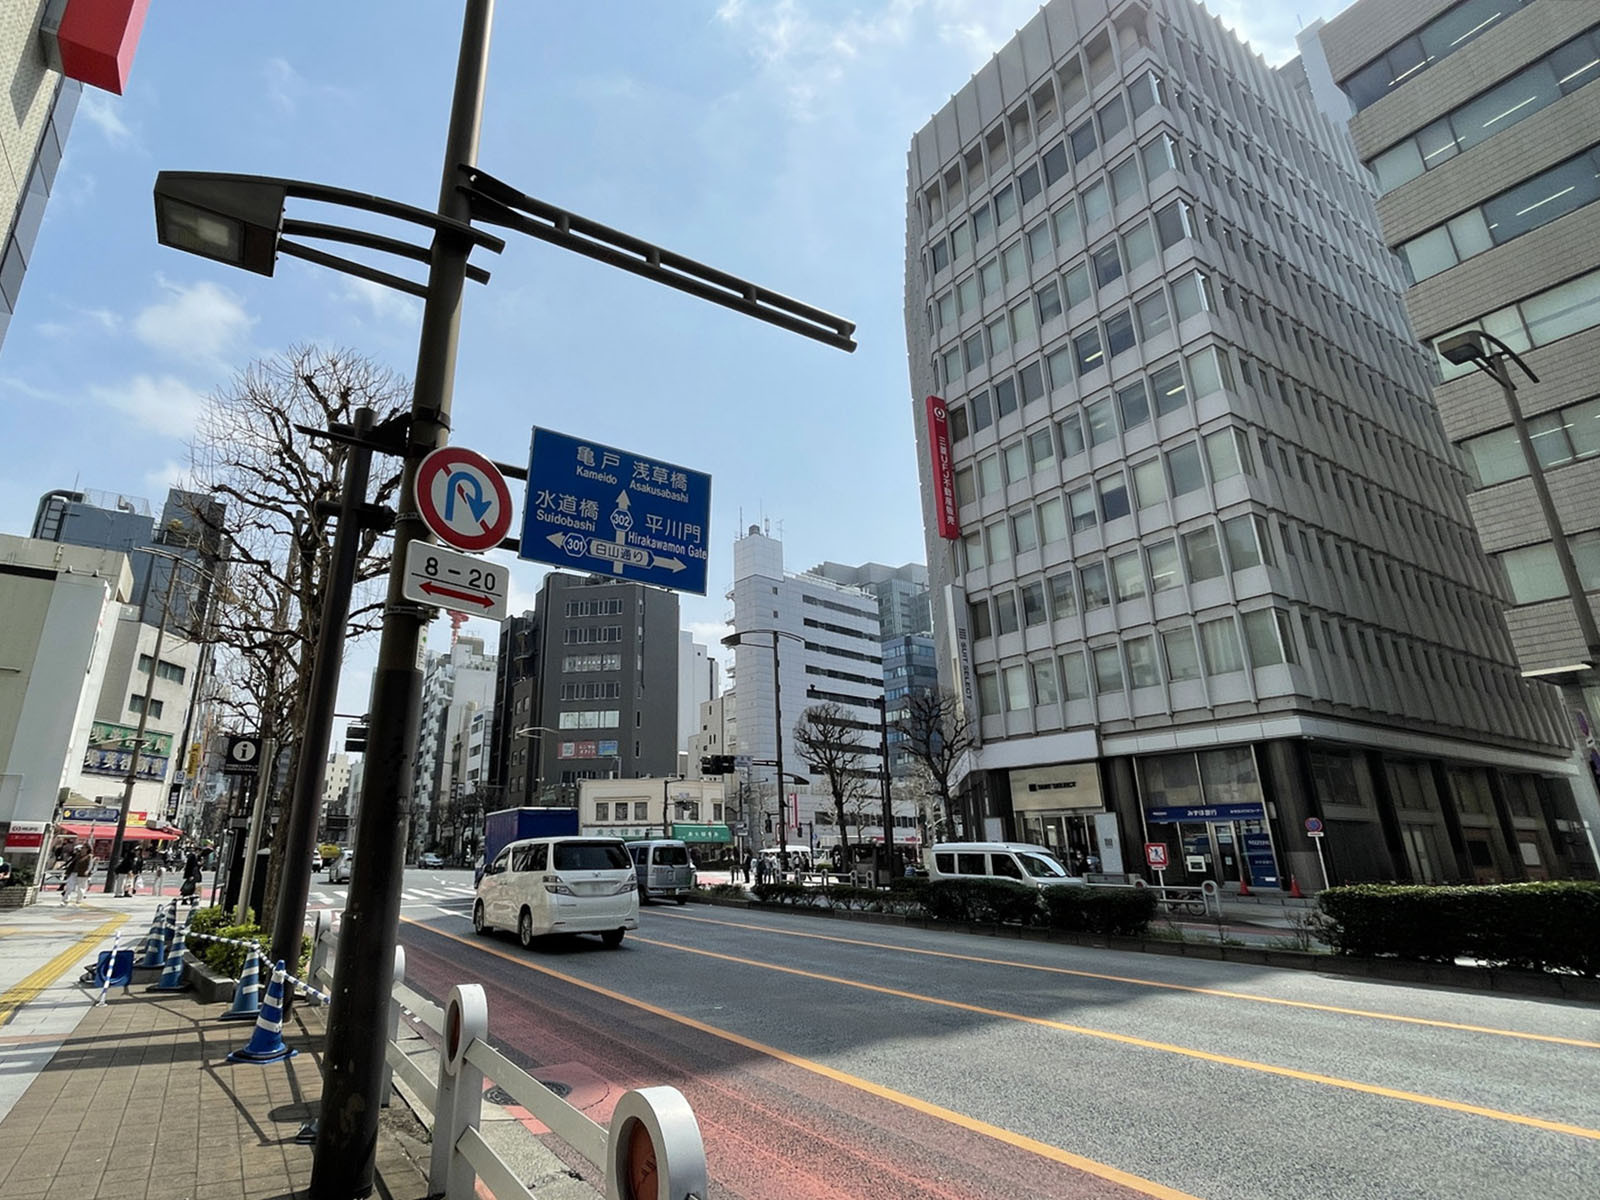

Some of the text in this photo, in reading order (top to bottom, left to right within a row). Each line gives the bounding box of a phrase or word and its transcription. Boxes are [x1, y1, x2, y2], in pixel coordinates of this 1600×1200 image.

[577, 446, 620, 469] 亀戸
[576, 465, 618, 485] Kameido
[632, 460, 688, 491] 浅草橋
[629, 479, 689, 503] Asakusabashi
[535, 489, 600, 520] 水道橋
[536, 509, 596, 532] Suidobashi
[613, 513, 630, 528] 302
[645, 513, 702, 543] 平川門
[567, 539, 584, 552] 301
[596, 543, 643, 563] 白山通り
[627, 531, 708, 560] Hirakawamon Gate
[963, 665, 972, 699] SELECT
[1187, 808, 1217, 817] みずほ銀行
